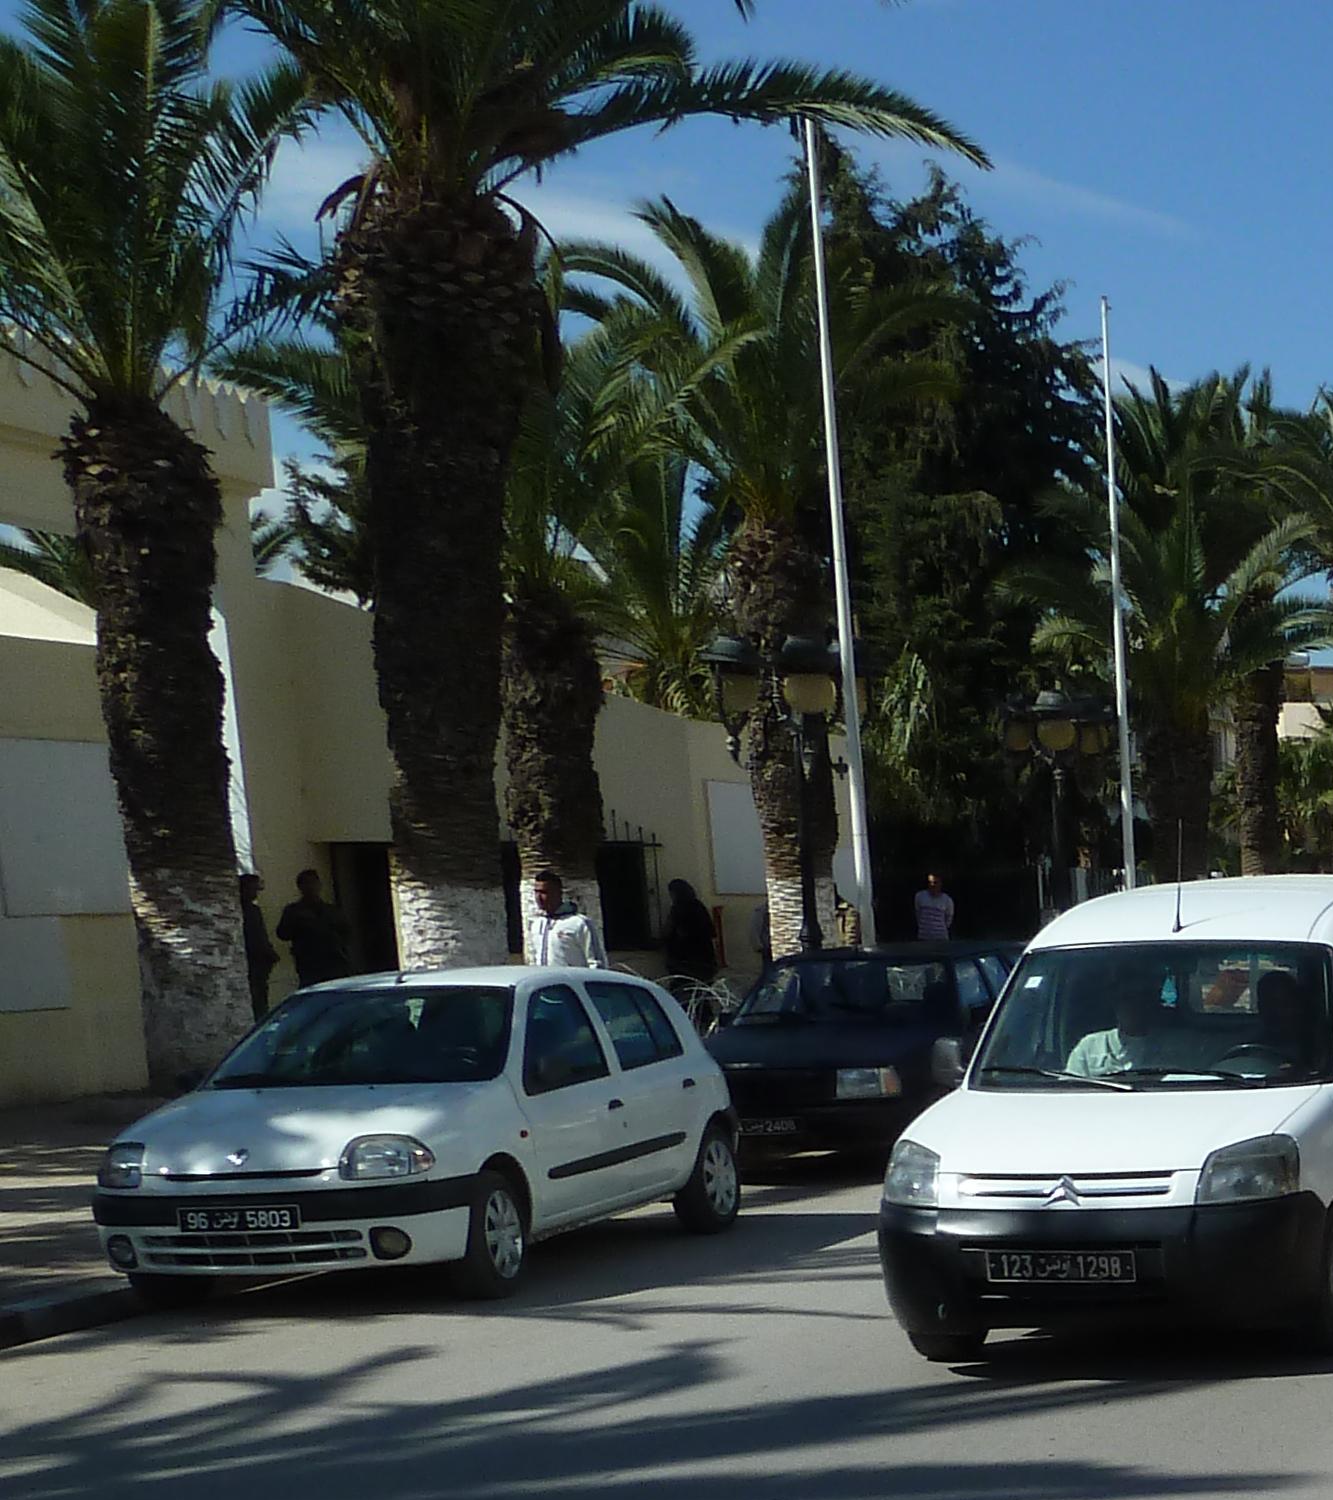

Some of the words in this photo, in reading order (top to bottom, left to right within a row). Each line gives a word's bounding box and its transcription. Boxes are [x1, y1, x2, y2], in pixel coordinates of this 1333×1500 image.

[186, 1212, 209, 1229] 96
[245, 1210, 291, 1228] 5803
[1001, 1254, 1033, 1277] 123
[1036, 1255, 1071, 1278] تونس
[1077, 1256, 1121, 1278] 1298
